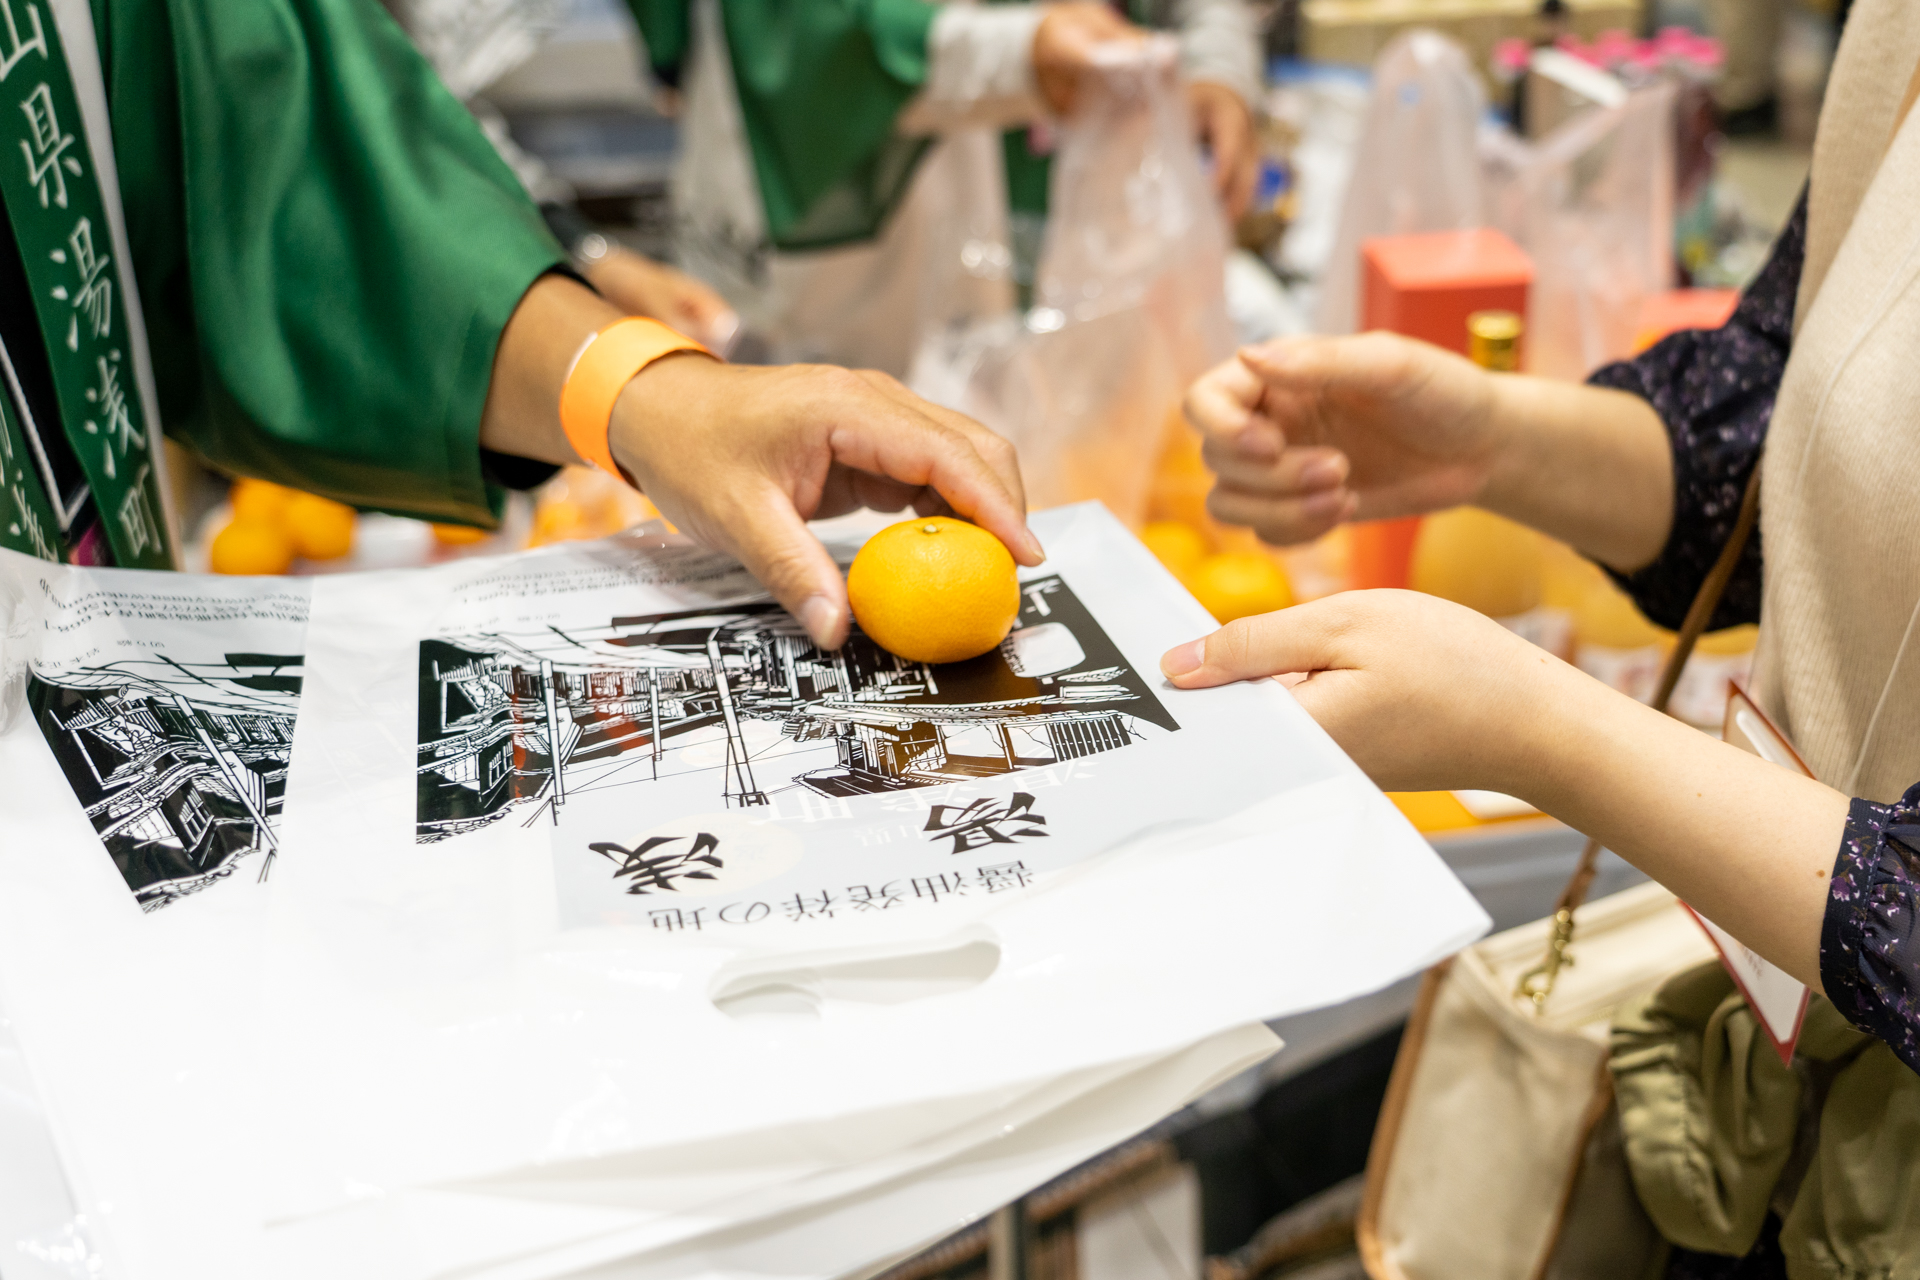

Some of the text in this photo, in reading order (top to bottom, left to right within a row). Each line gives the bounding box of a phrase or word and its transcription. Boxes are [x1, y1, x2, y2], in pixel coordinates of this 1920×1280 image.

[588, 792, 1050, 895] 湯 浅
[648, 860, 1035, 932] 醤油発祥の地
